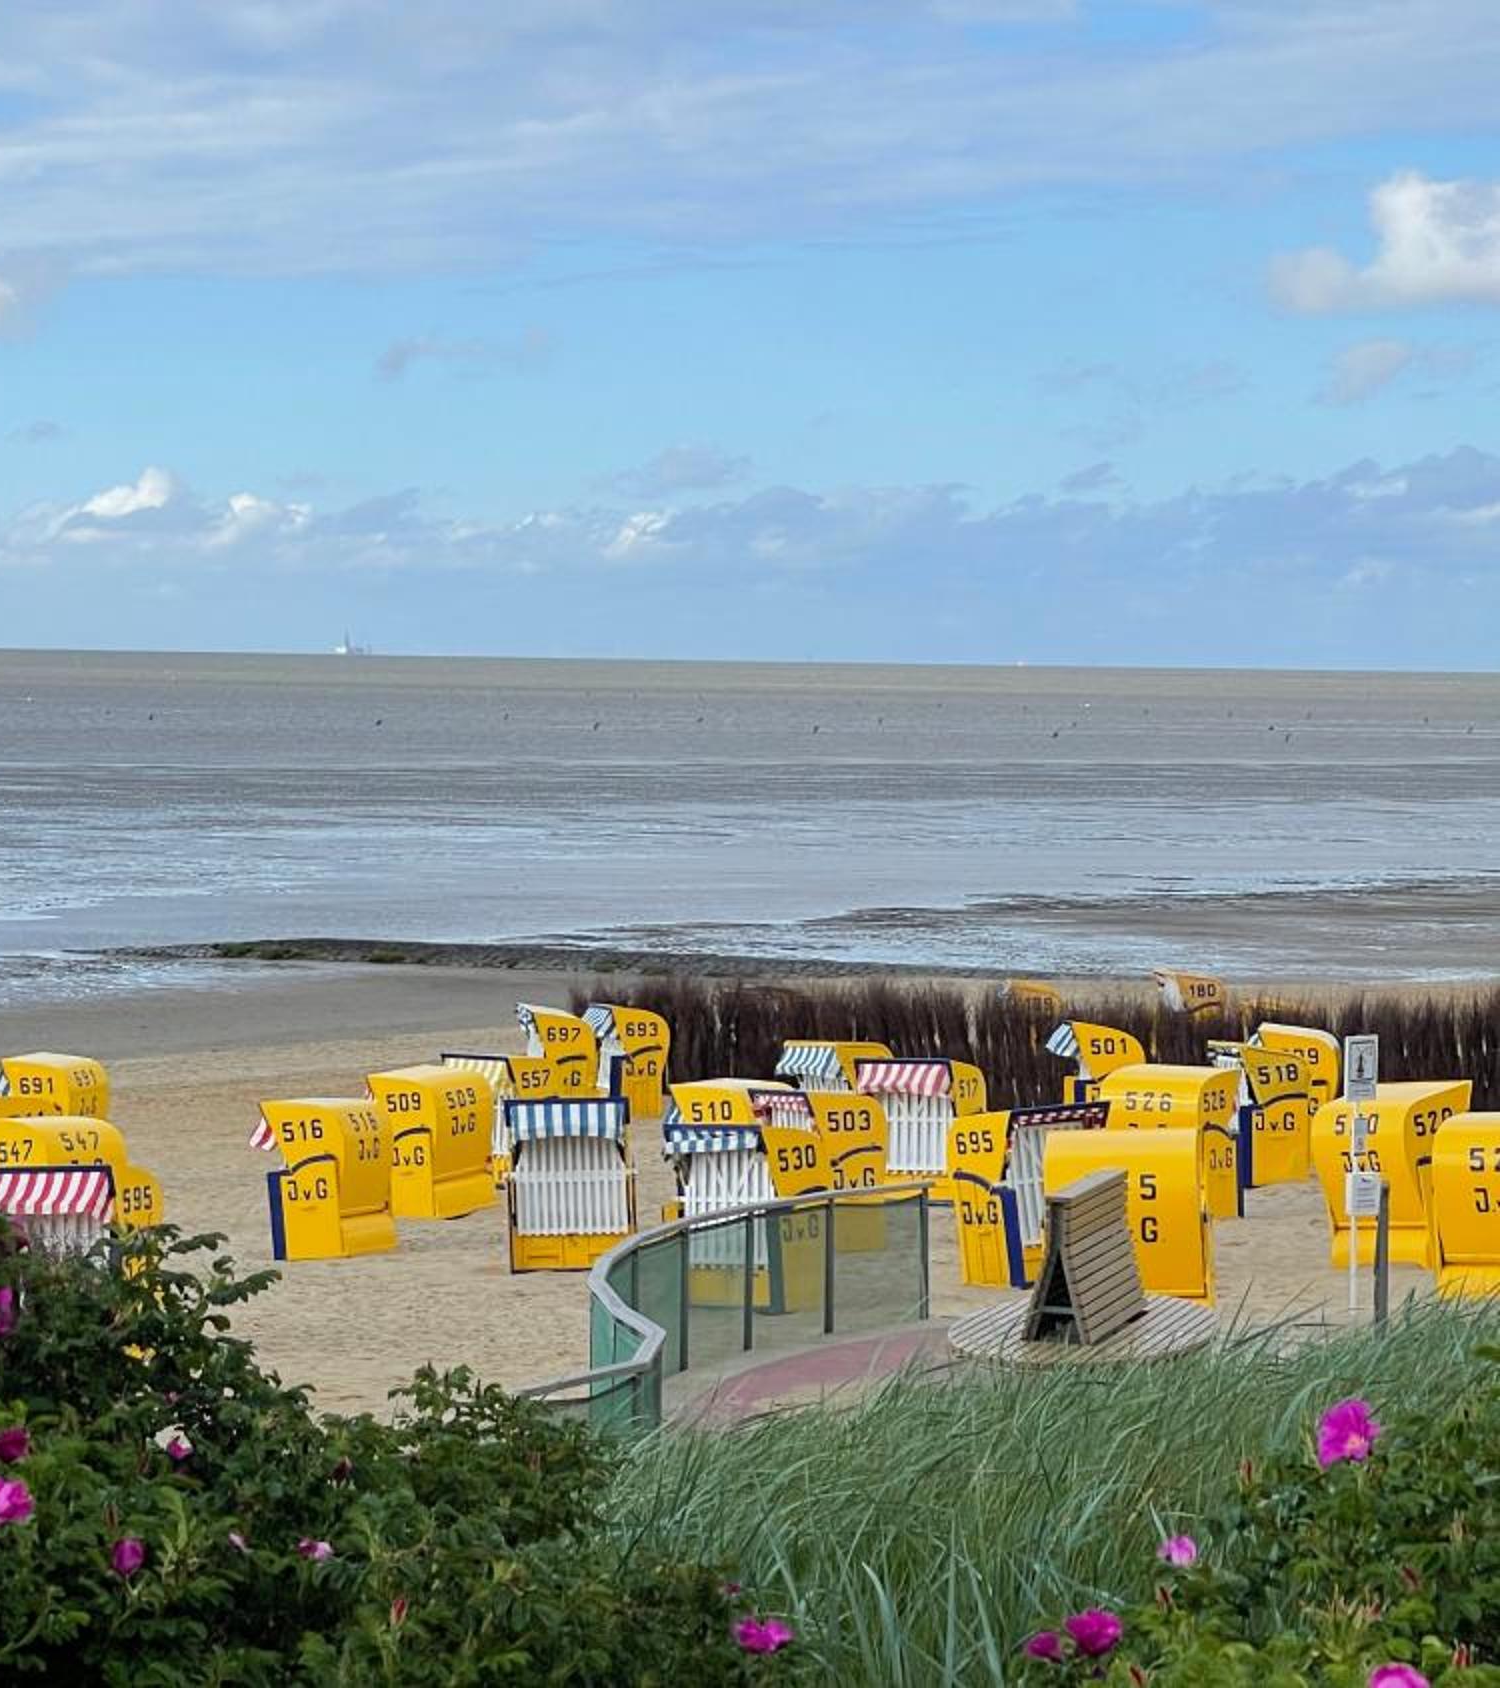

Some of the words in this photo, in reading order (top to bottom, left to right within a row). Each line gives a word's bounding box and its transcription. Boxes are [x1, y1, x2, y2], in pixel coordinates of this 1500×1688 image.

[1190, 983, 1216, 997] 180
[547, 1026, 580, 1042] 697
[626, 1022, 658, 1037] 693
[1091, 1037, 1127, 1055] 501
[521, 1069, 550, 1089] 557
[1257, 1063, 1299, 1085] 518
[19, 1077, 53, 1094] 691
[386, 1092, 421, 1112] 509
[445, 1087, 477, 1109] 509
[1126, 1091, 1172, 1112] 526
[1203, 1089, 1227, 1113] 526
[692, 1100, 733, 1122] 510
[827, 1110, 871, 1132] 503
[281, 1119, 324, 1142] 516
[1334, 1113, 1379, 1135] 50
[58, 1131, 100, 1152] 547
[956, 1130, 993, 1155] 695
[777, 1144, 817, 1172] 530
[123, 1185, 153, 1214] 595
